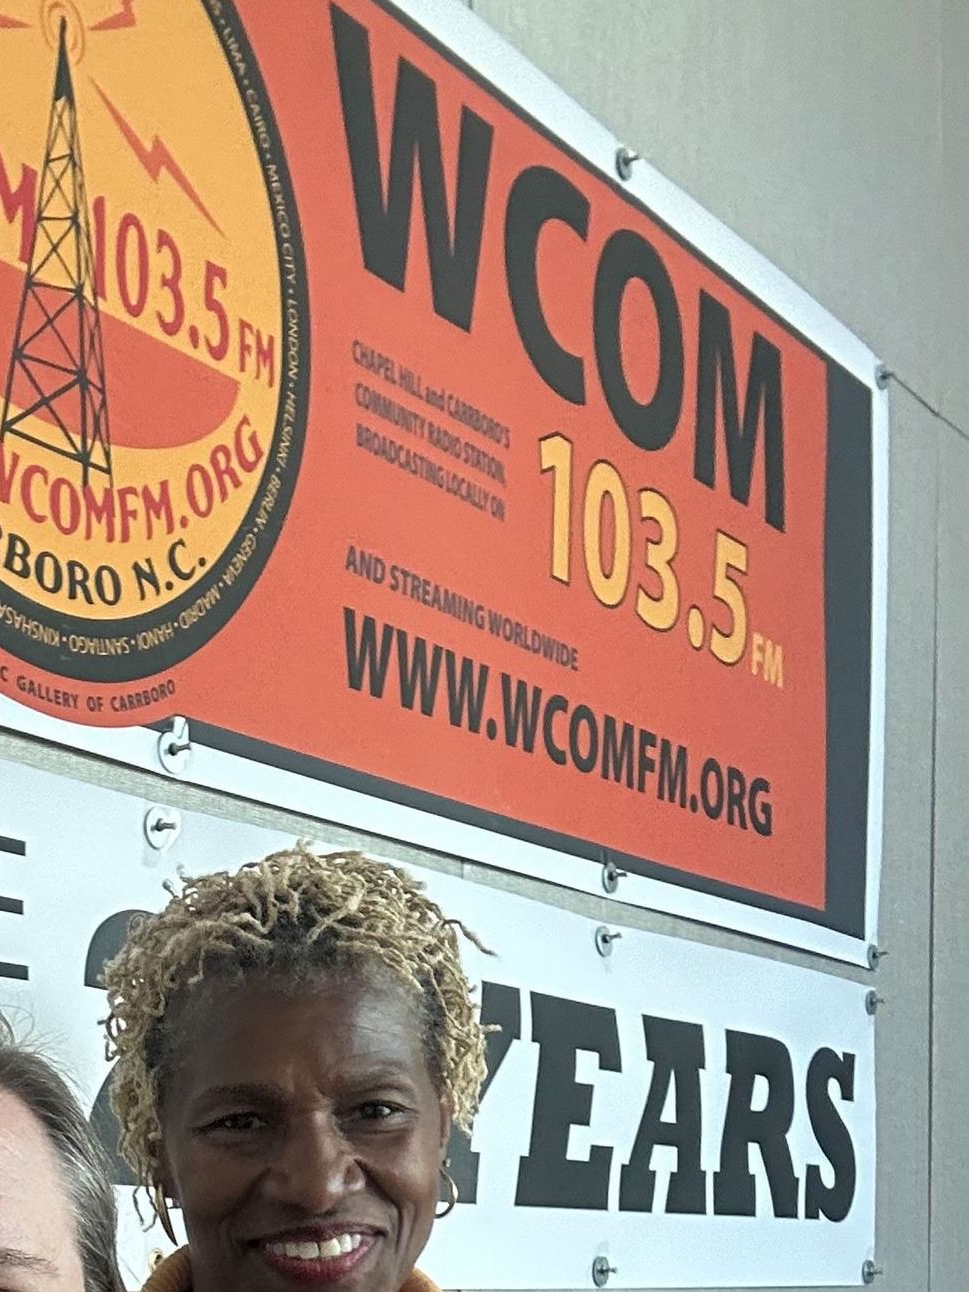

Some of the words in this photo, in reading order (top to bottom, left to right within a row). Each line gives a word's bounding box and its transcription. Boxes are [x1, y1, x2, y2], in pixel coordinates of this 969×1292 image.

[222, 27, 247, 76] LIMA
[245, 89, 271, 149] CAIRO
[266, 164, 292, 239] MEXICO
[92, 196, 230, 362] 103.5
[239, 318, 275, 389] FM
[281, 242, 297, 285] CITY
[330, 2, 786, 533] WCOM
[287, 298, 300, 380] LONDON
[352, 339, 397, 385] CHAPEL
[398, 364, 424, 400] HILL
[425, 386, 445, 412] and
[276, 390, 297, 470] HELSINKI
[355, 382, 427, 439] COMMUNITY
[427, 421, 463, 460] RADIO
[253, 473, 282, 531] BERLIN
[356, 423, 445, 489] BROADCASTING
[445, 469, 490, 512] LOCALLY
[490, 495, 506, 522] ON
[132, 538, 207, 601] N.C.
[223, 532, 258, 587] GENEVA
[538, 431, 748, 667] 103.5
[750, 632, 784, 690] FM
[69, 634, 130, 656] SANTIAGO
[135, 620, 175, 651] HANOI
[179, 588, 222, 630] MADRID
[345, 545, 386, 585] AND
[389, 564, 486, 631] STREAMING
[486, 608, 580, 672] WORLDWIDE
[16, 675, 79, 710] GALLERY
[86, 695, 105, 713] OF
[110, 678, 176, 713] CARRBORO
[342, 606, 774, 837] WWW.WCOMFM.ORG
